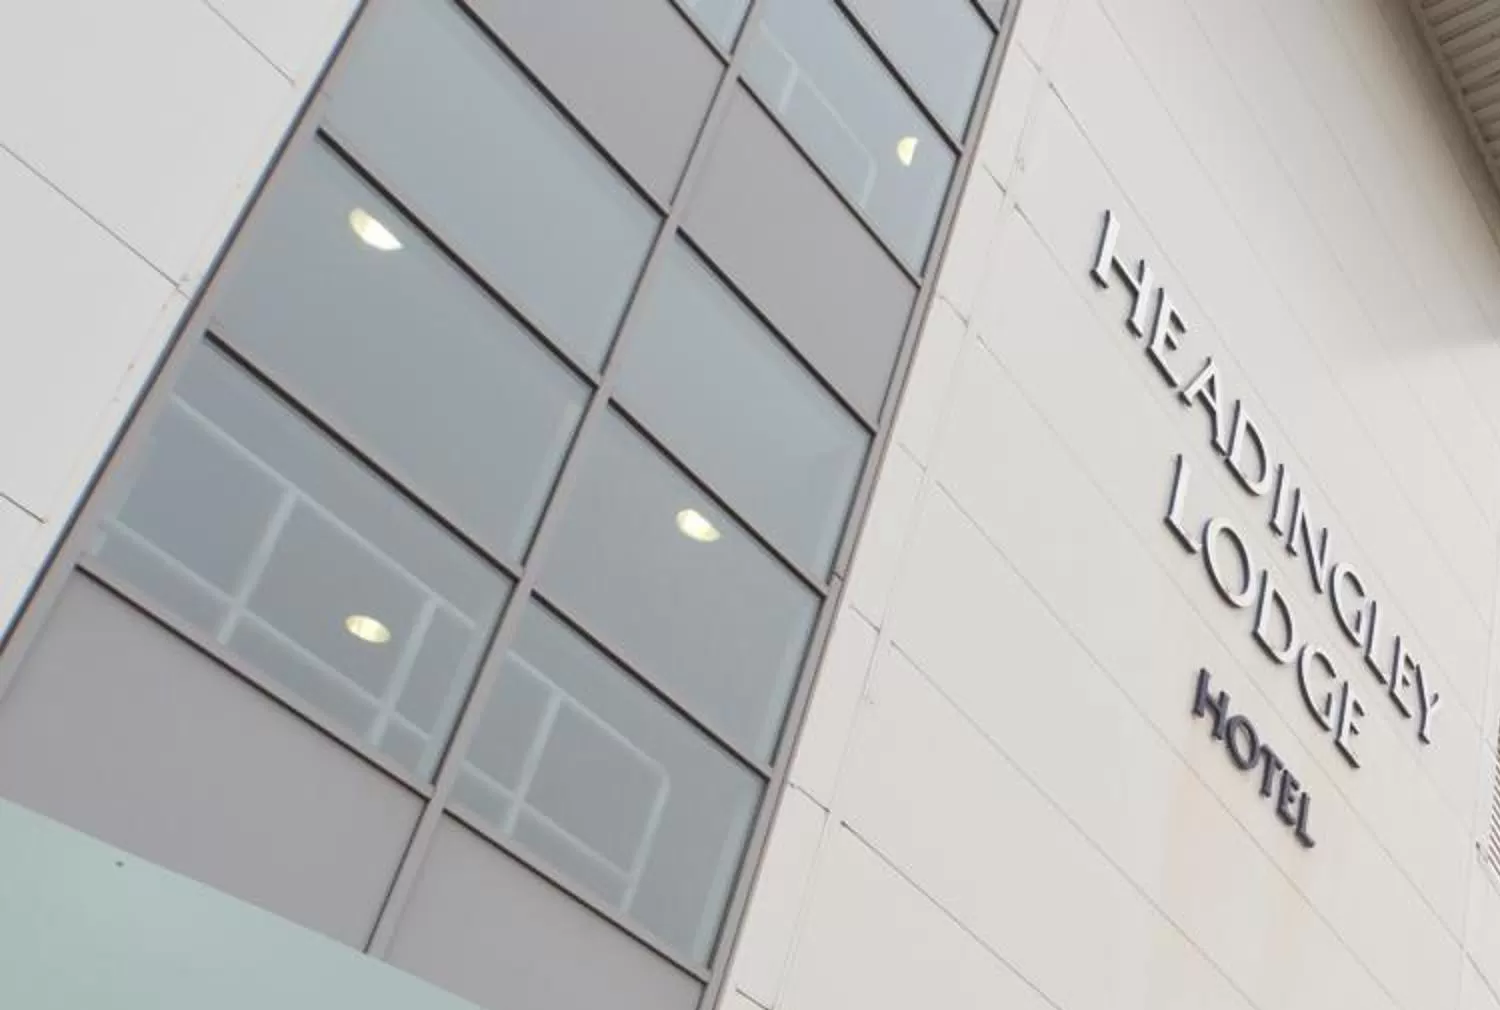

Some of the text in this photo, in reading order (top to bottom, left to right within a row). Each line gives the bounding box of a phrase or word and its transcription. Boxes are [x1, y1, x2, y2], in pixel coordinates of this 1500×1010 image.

[1090, 208, 1438, 745] HEADINGLEY
[1164, 453, 1364, 770] LODGE
[1191, 668, 1315, 848] HOTEL
